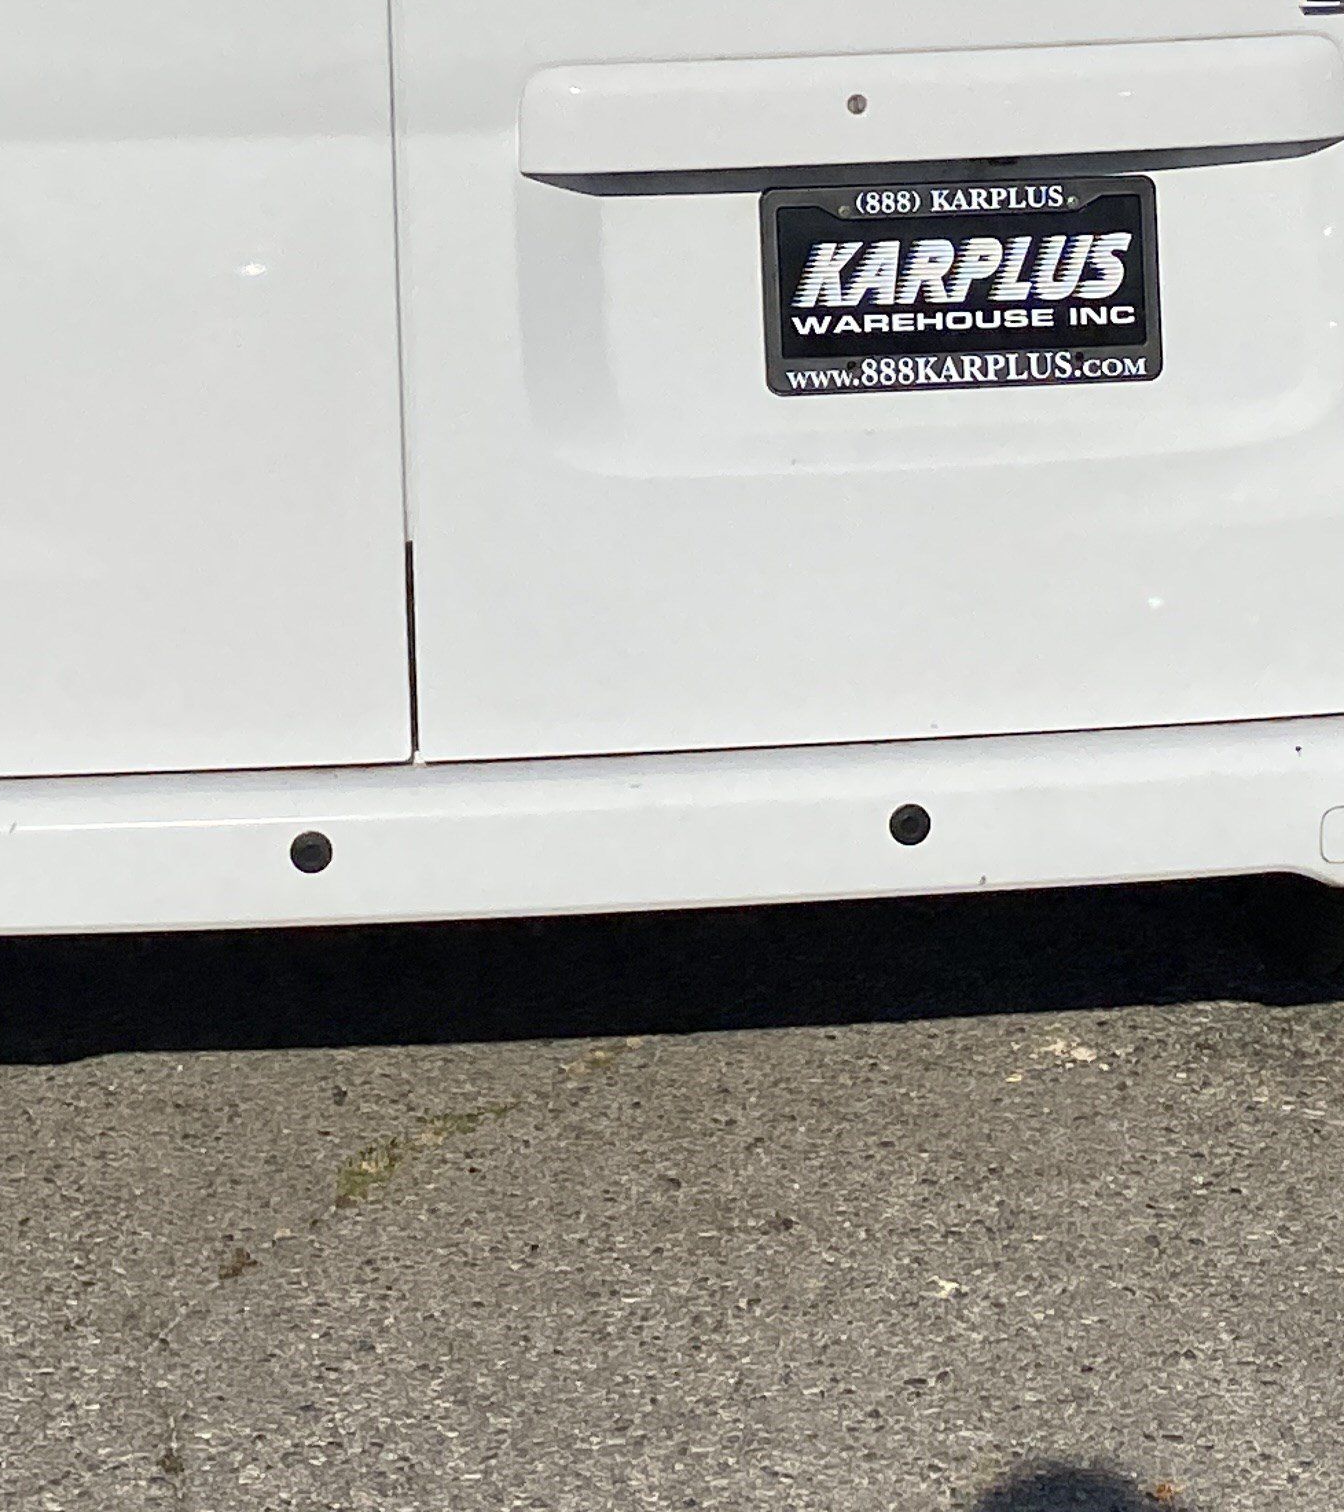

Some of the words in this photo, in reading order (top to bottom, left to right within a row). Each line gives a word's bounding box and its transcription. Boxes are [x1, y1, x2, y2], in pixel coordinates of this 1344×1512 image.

[855, 190, 921, 215] (888)
[930, 185, 1064, 213] KARPLUS
[791, 231, 1133, 309] KARPLUS
[791, 308, 1055, 336] WAREHOUSE
[1068, 305, 1136, 326] INC
